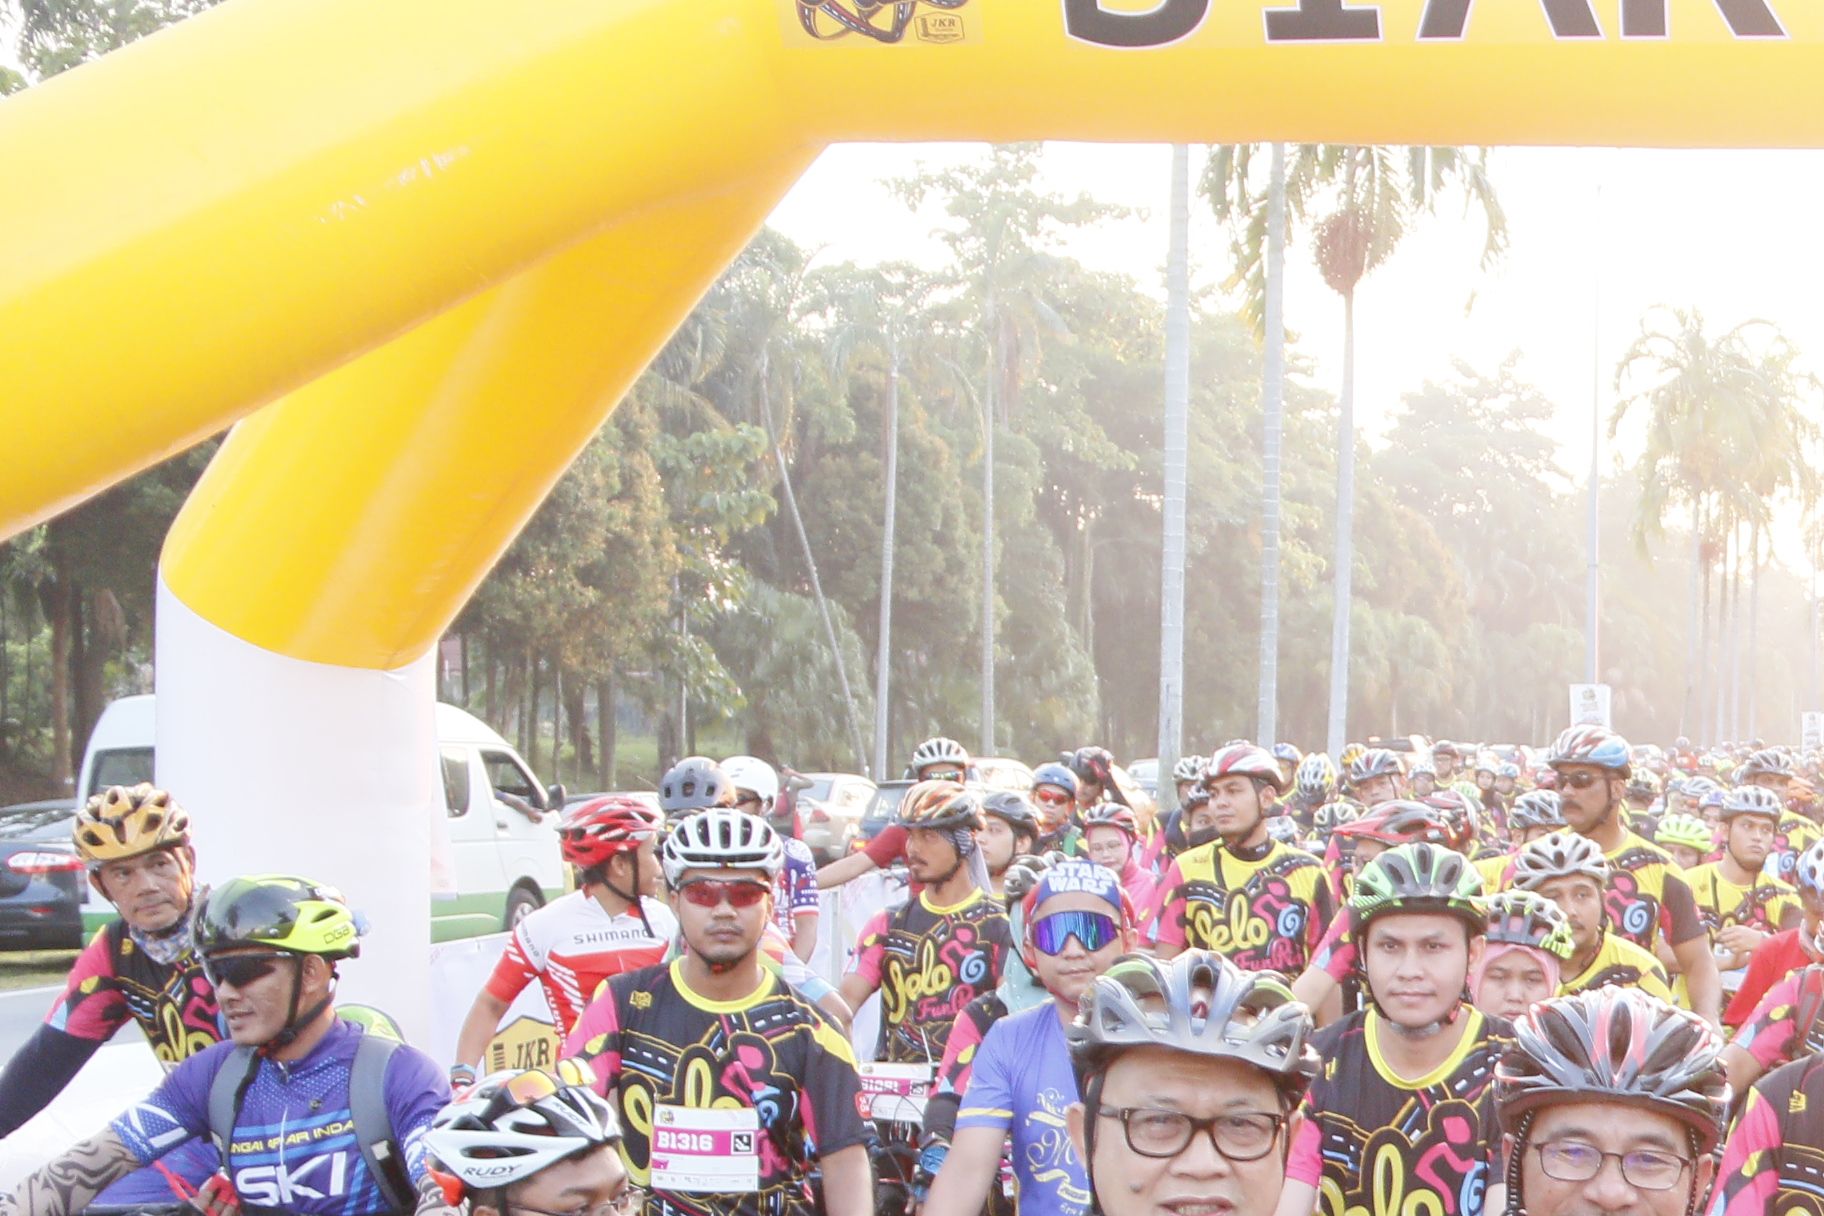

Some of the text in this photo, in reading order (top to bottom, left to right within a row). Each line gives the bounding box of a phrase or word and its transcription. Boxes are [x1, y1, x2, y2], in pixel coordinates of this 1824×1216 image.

[1047, 876, 1112, 895] WARS
[512, 1038, 550, 1069] JKR
[313, 1119, 355, 1139] INDA
[657, 1131, 713, 1151] B1316
[236, 1146, 347, 1207] SKI
[463, 1164, 522, 1177] RUDY
